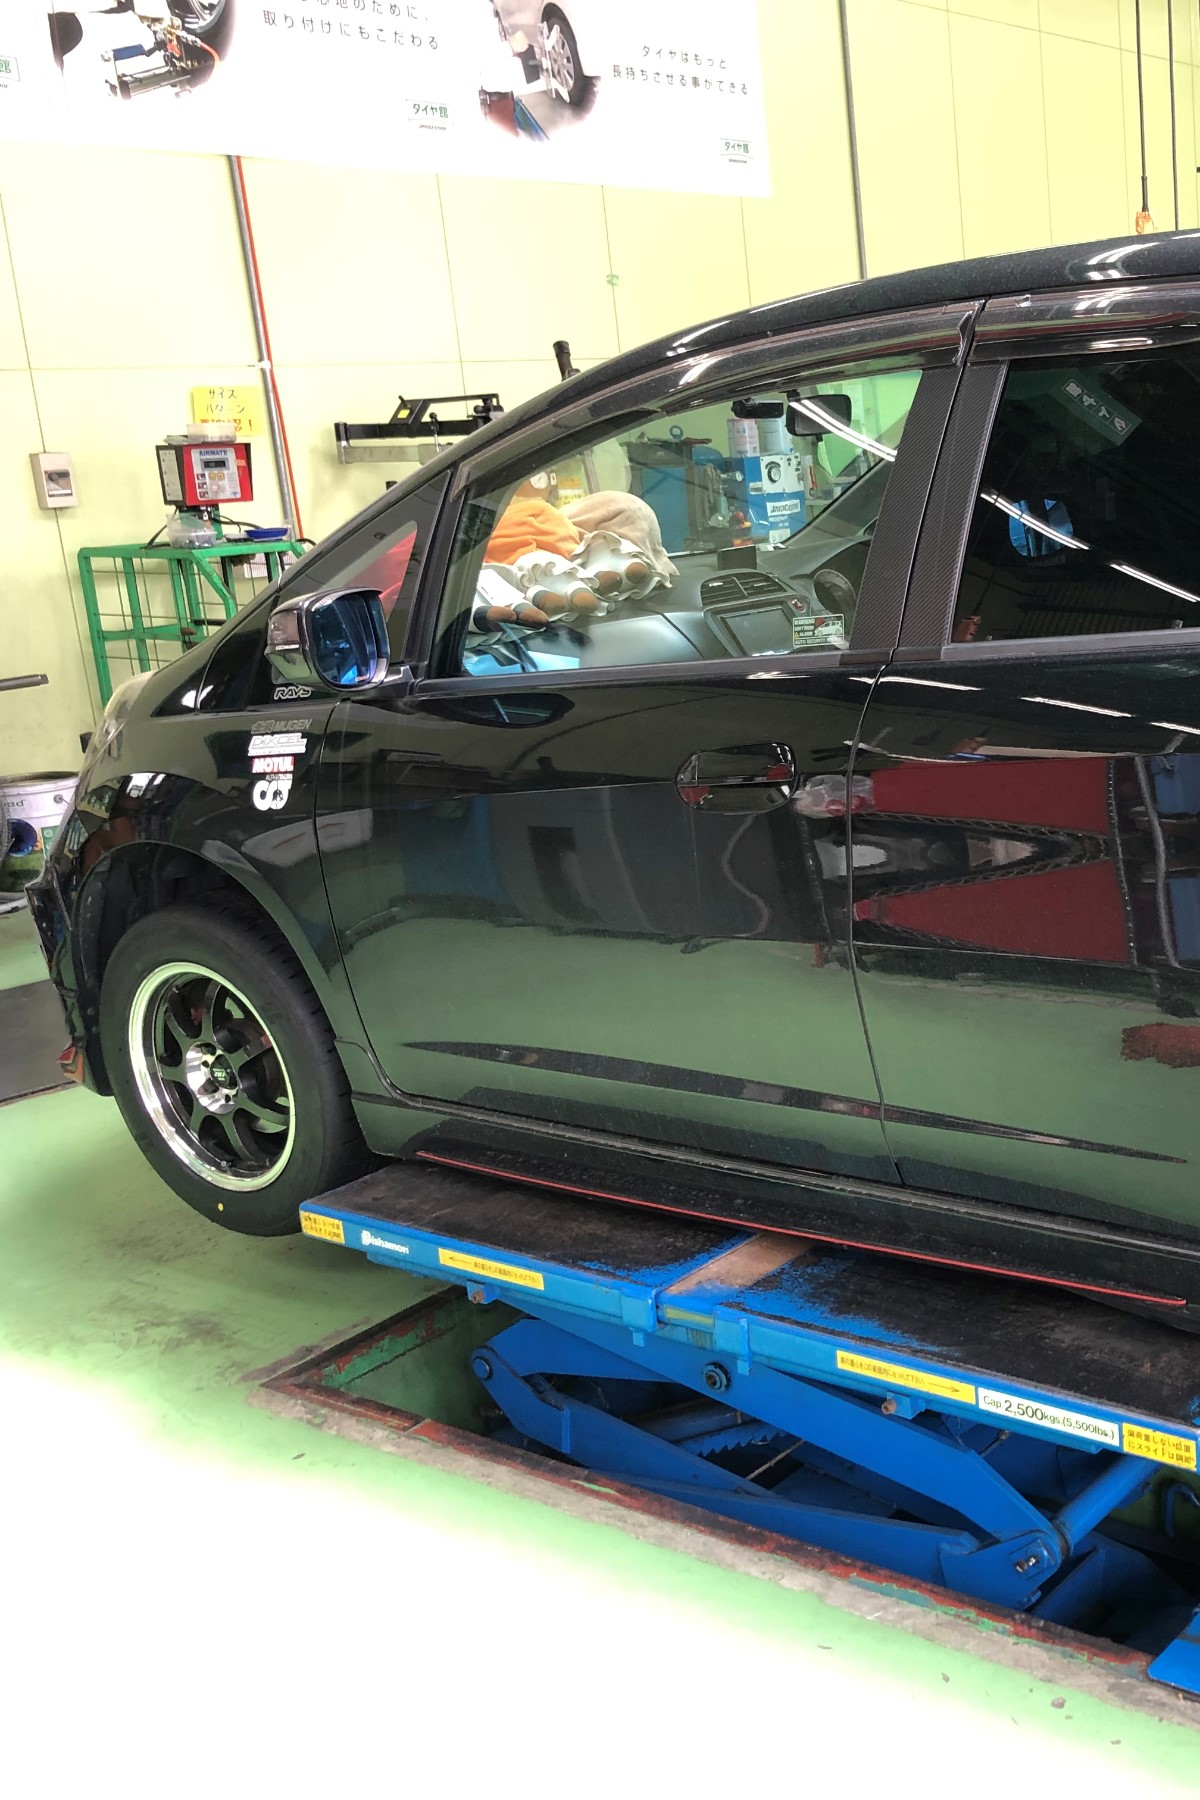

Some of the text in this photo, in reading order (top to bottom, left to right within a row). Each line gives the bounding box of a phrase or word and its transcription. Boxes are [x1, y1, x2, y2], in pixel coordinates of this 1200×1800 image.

[263, 9, 438, 50] 取り付けにもこだわる
[642, 45, 726, 69] タイヤはもっと
[613, 64, 748, 95] 長持ちさせる事ができる
[413, 103, 449, 119] タイヤ館
[724, 141, 750, 154] タイヤ館
[274, 686, 312, 700] RAYS
[274, 718, 313, 732] MUGEN
[250, 733, 307, 747] DIXCEL
[252, 757, 294, 773] MOTUL
[361, 1229, 409, 1254] Bishamon
